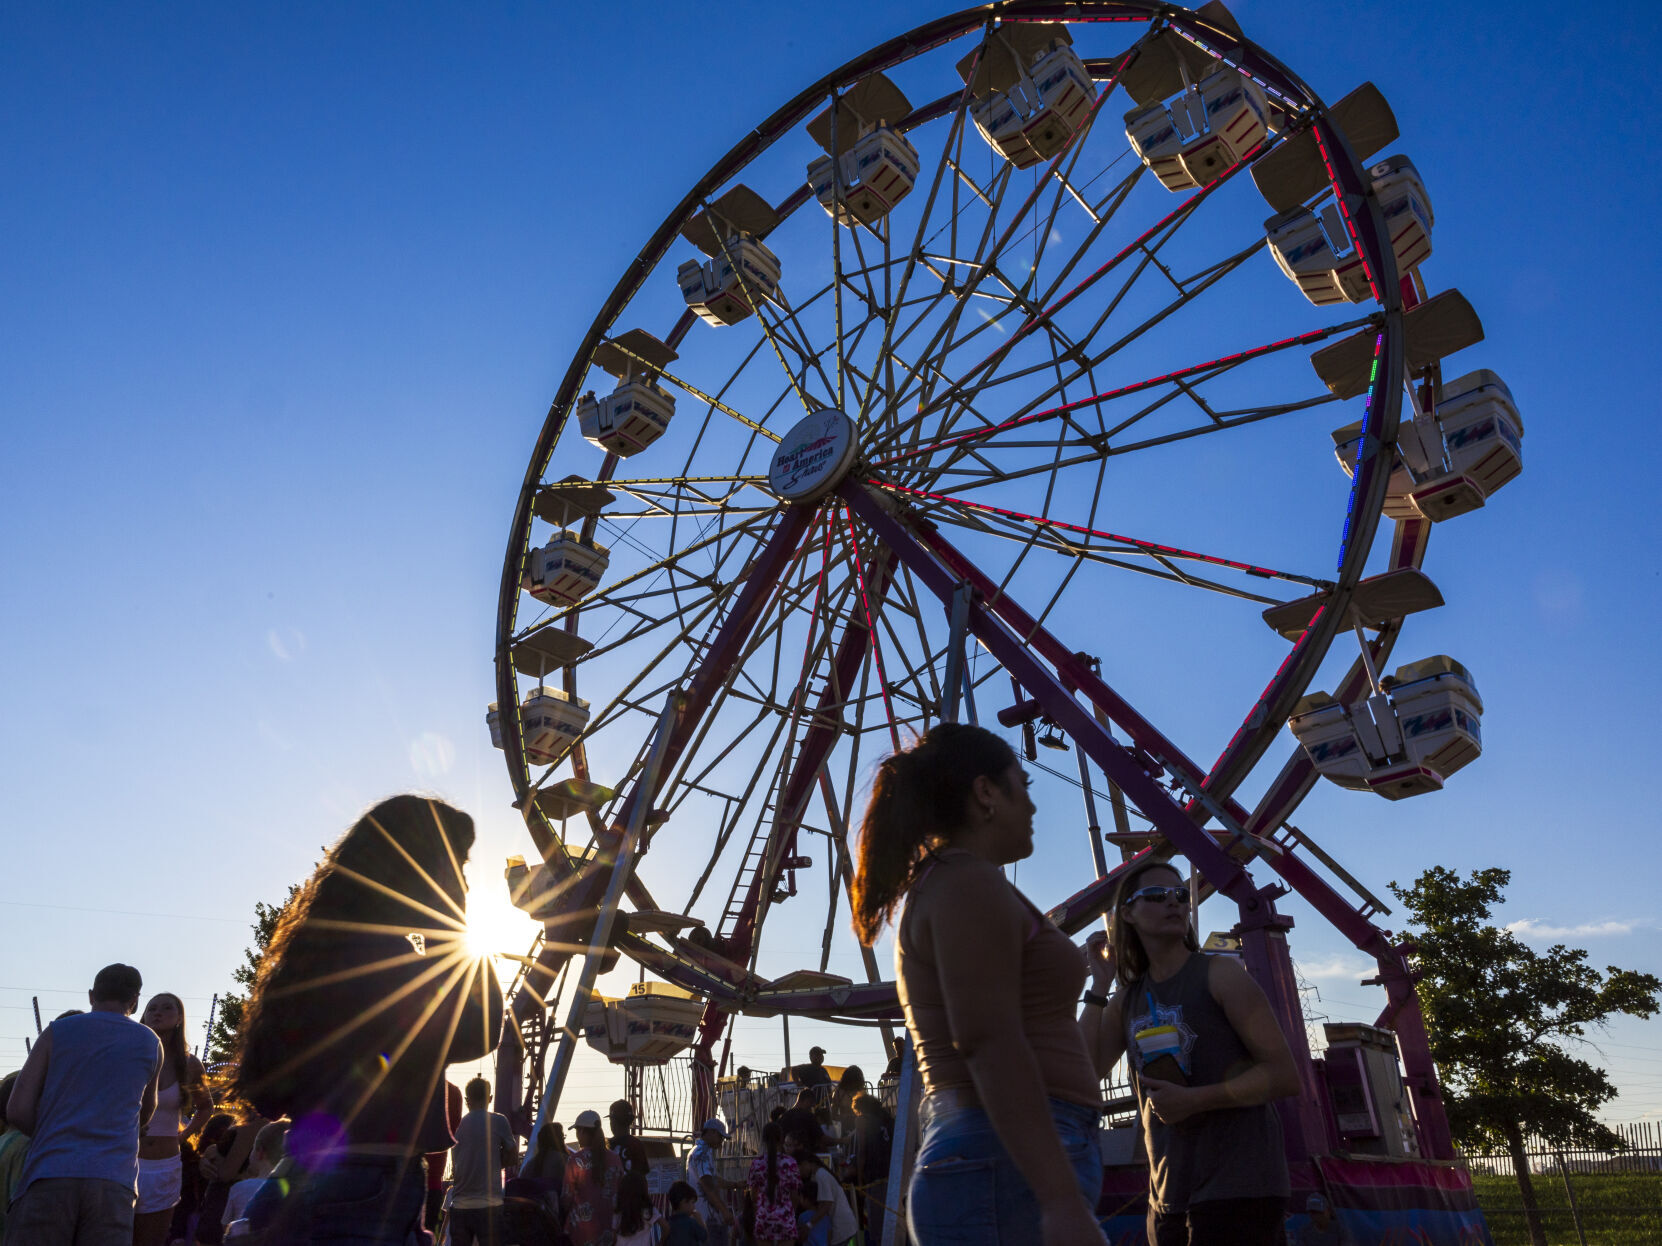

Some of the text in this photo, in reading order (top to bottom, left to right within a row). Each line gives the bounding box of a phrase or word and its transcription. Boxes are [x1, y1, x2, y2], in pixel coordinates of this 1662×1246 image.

[1371, 161, 1390, 177] 6
[792, 446, 833, 471] America
[632, 983, 646, 995] 15
